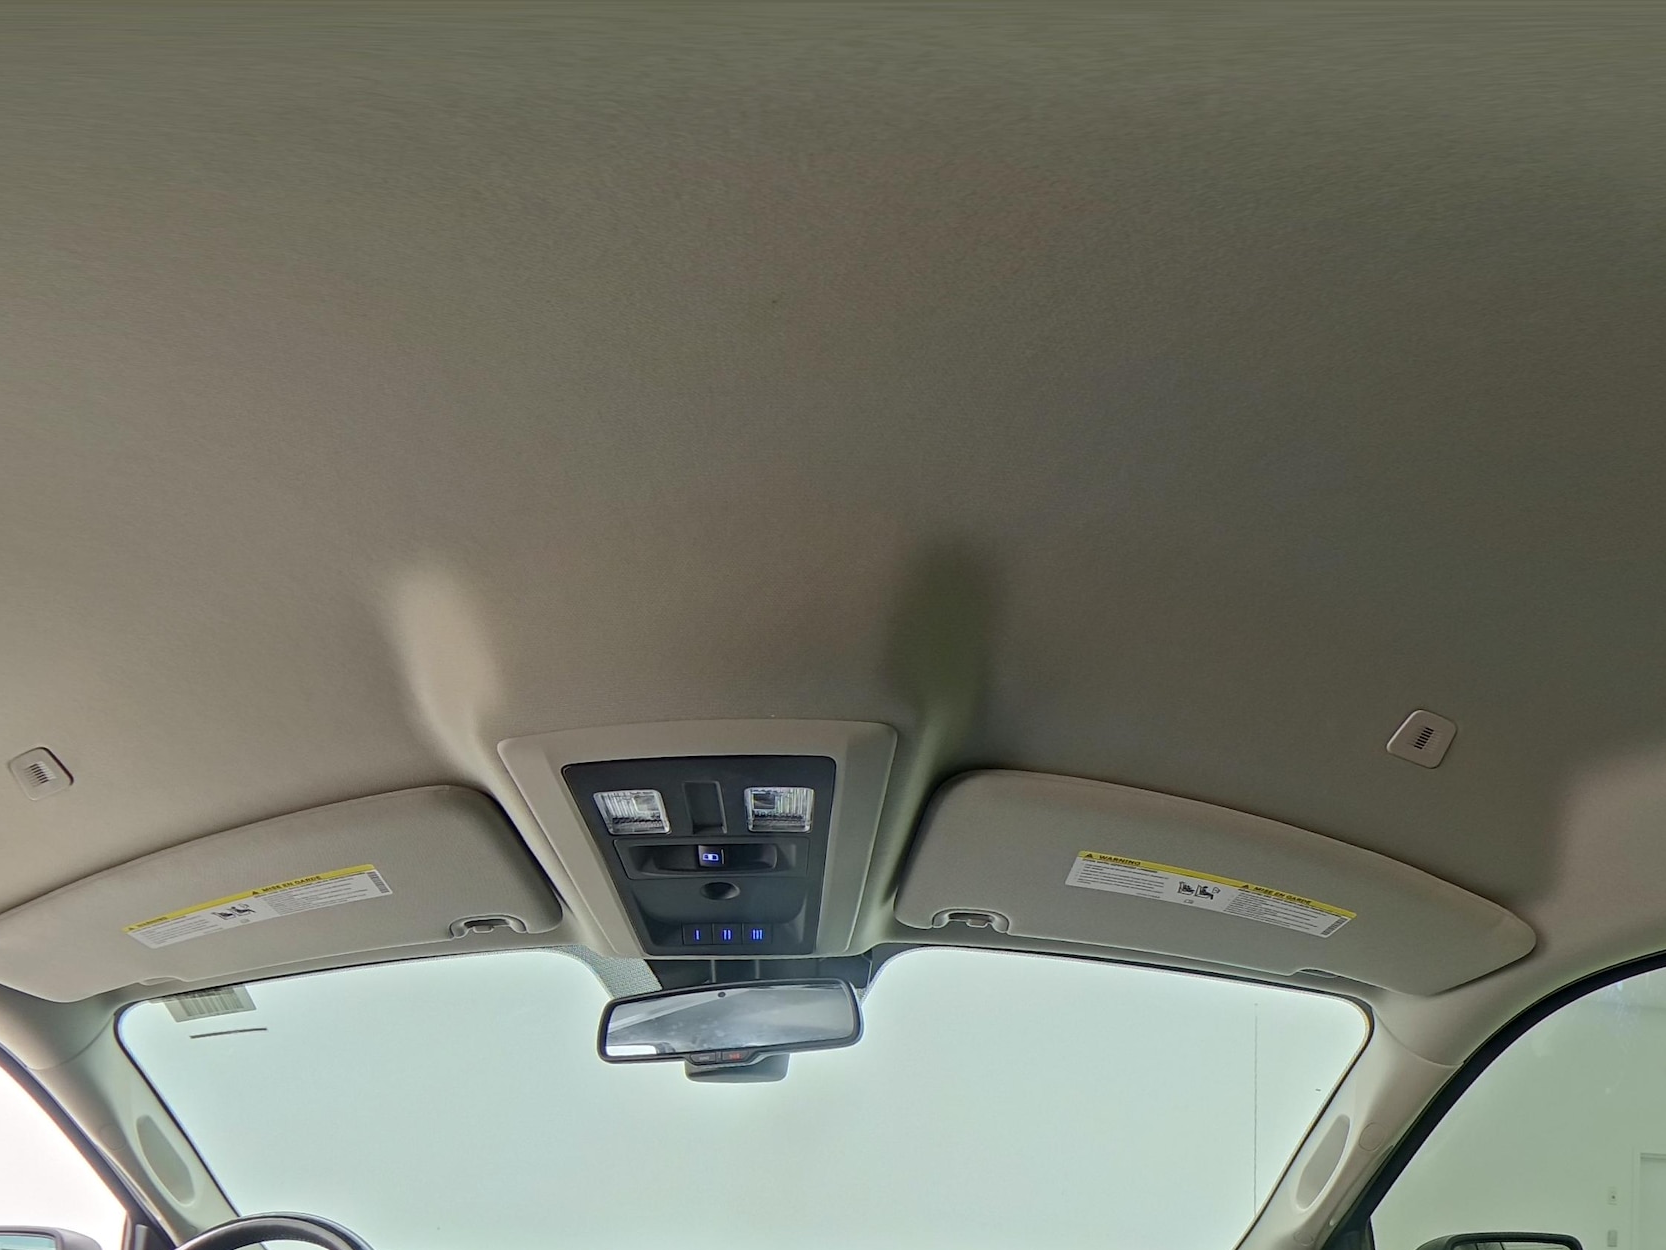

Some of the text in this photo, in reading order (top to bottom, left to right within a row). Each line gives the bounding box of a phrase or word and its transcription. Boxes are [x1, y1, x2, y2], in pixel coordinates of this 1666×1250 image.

[1099, 855, 1141, 866] WARNING
[294, 876, 321, 885] GARDE
[1254, 886, 1272, 895] MISE
[1286, 894, 1312, 905] GARDE
